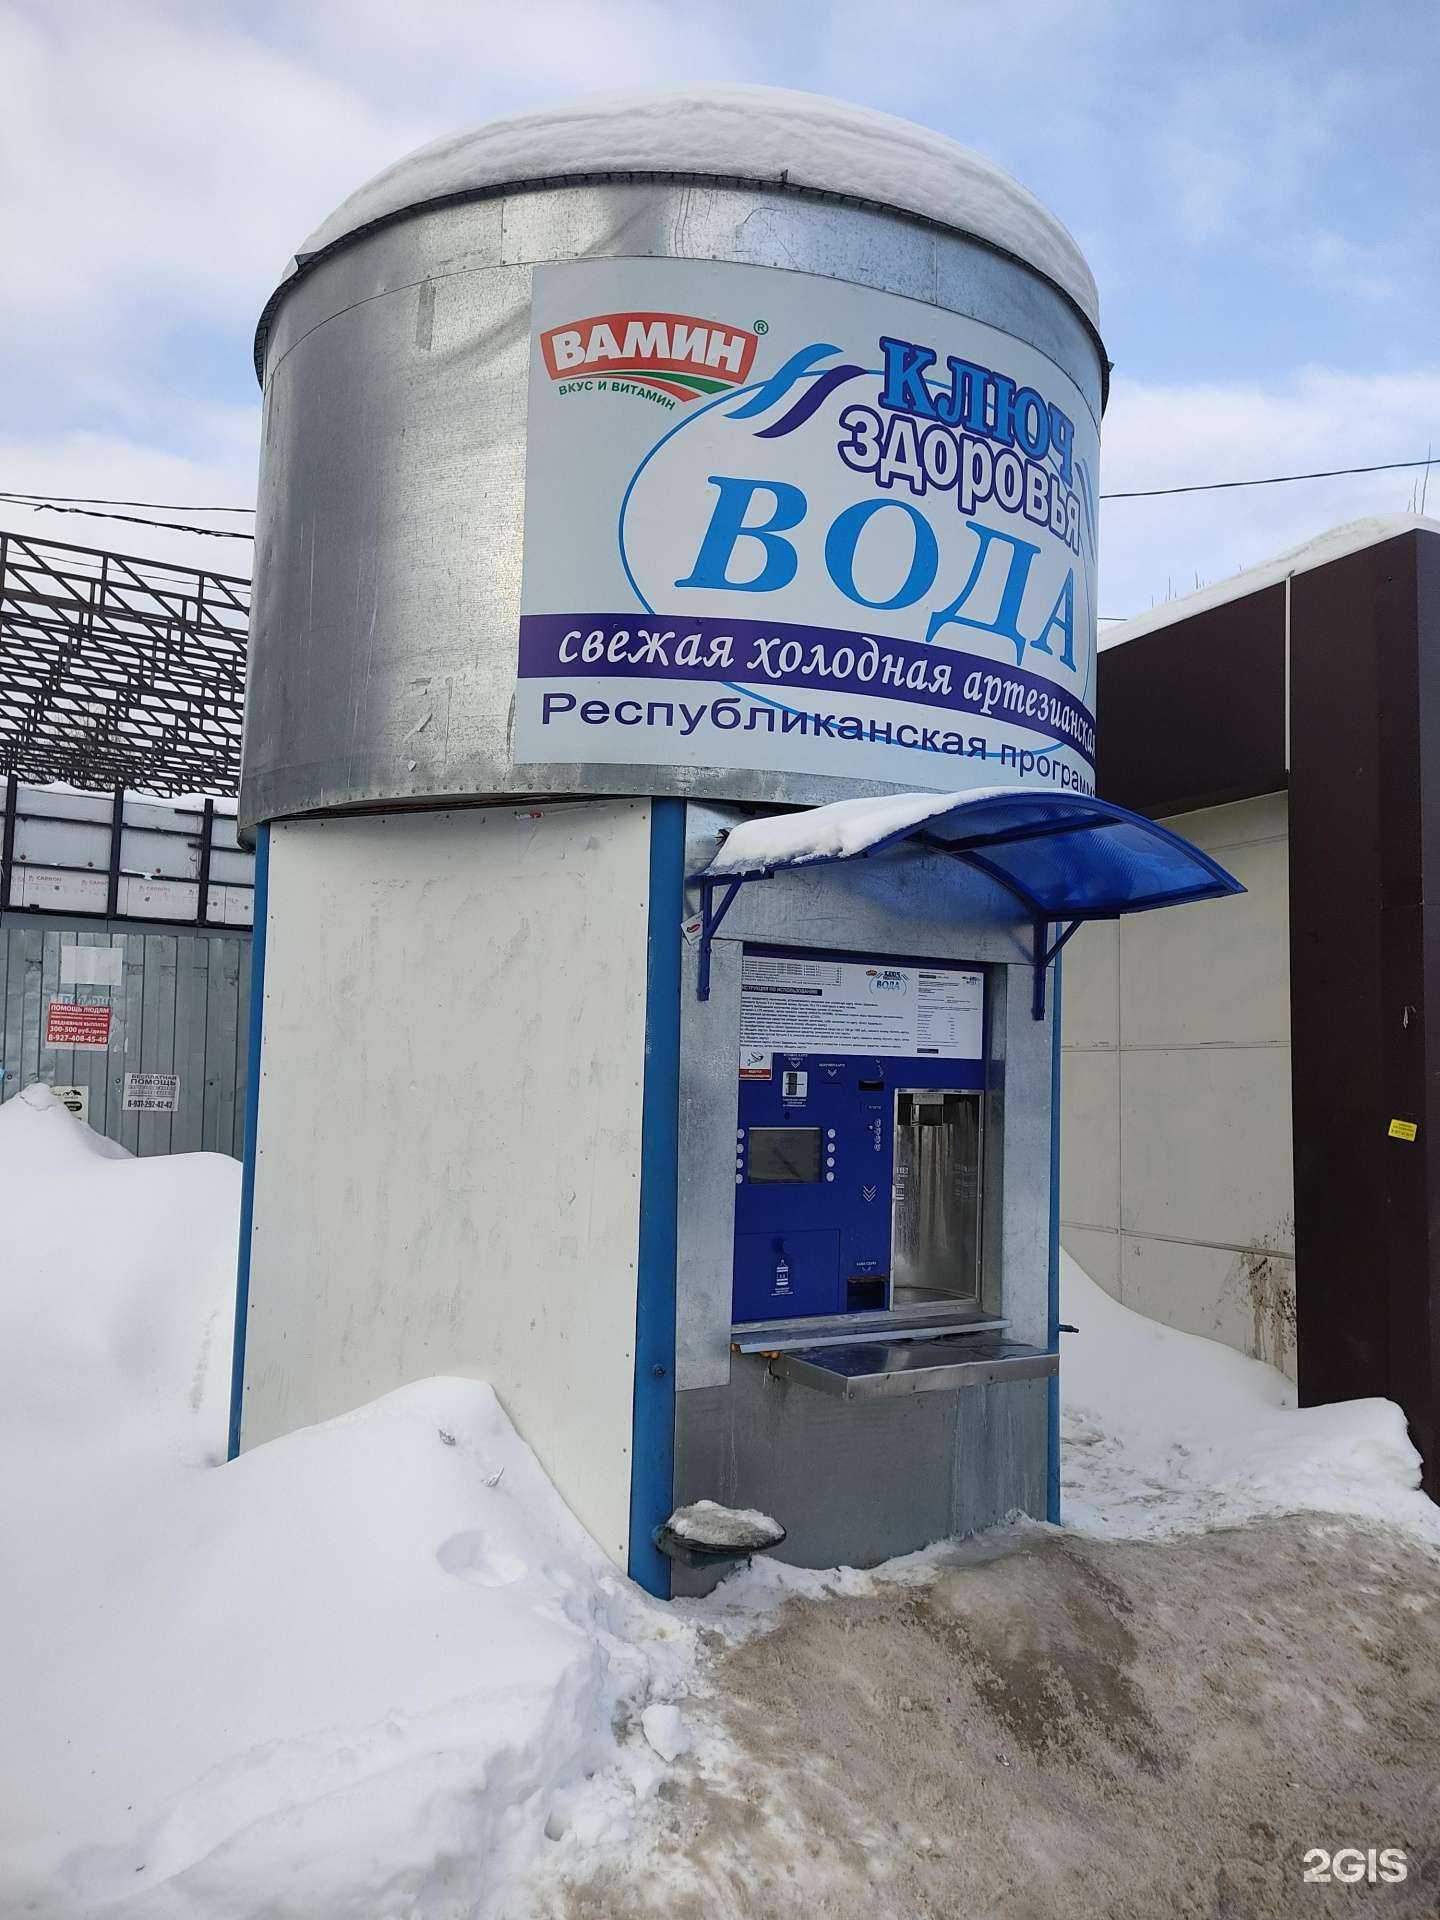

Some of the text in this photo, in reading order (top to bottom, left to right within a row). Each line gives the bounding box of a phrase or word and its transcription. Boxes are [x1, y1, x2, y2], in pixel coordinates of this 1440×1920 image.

[551, 320, 746, 374] ВАМИН
[558, 380, 676, 411] ВКУС И ВИТАМИН
[878, 335, 1075, 489] КЛЮЧ
[674, 475, 1078, 672] ВОДА
[558, 628, 735, 668] свежая
[746, 636, 953, 696] холодная
[541, 692, 987, 761] Республиканская
